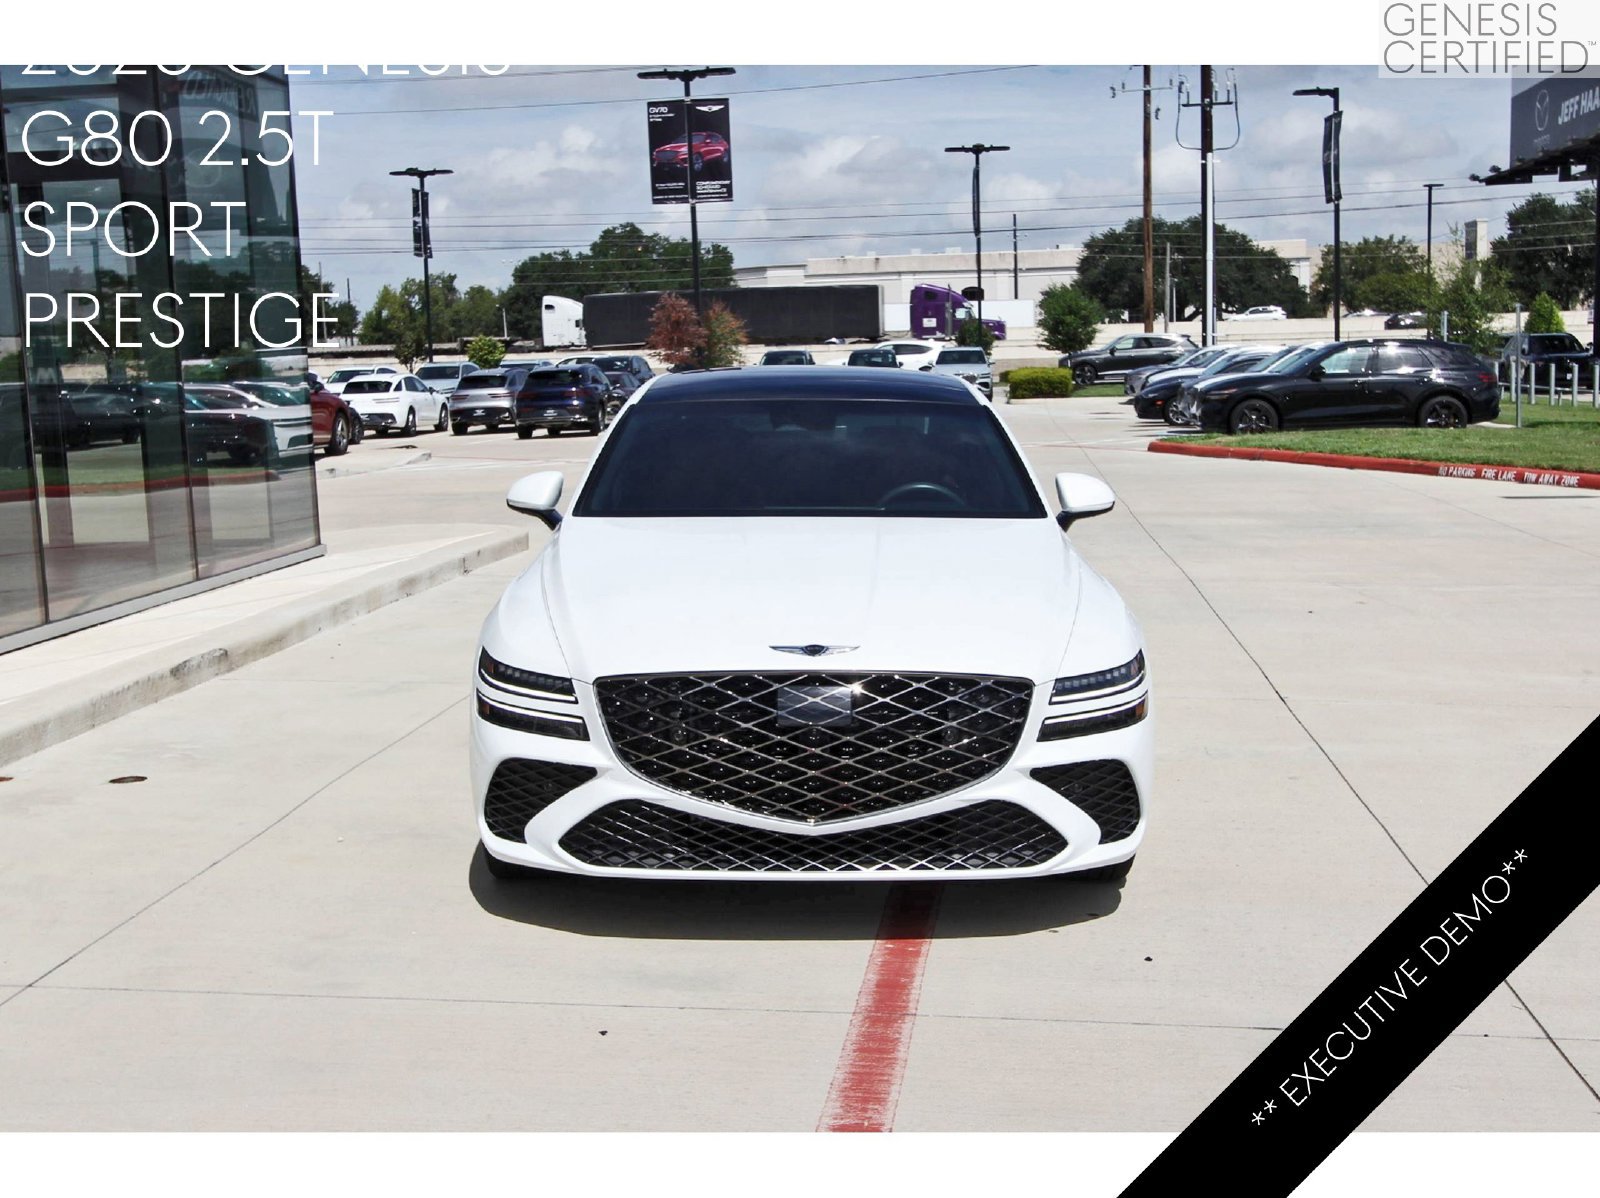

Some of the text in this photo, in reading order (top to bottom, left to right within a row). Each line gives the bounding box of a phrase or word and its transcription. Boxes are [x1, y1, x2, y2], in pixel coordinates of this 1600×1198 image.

[1558, 95, 1580, 125] JEFF
[1438, 466, 1580, 487] NO PARKING FIRE LANE TOW AWAY ZONE
